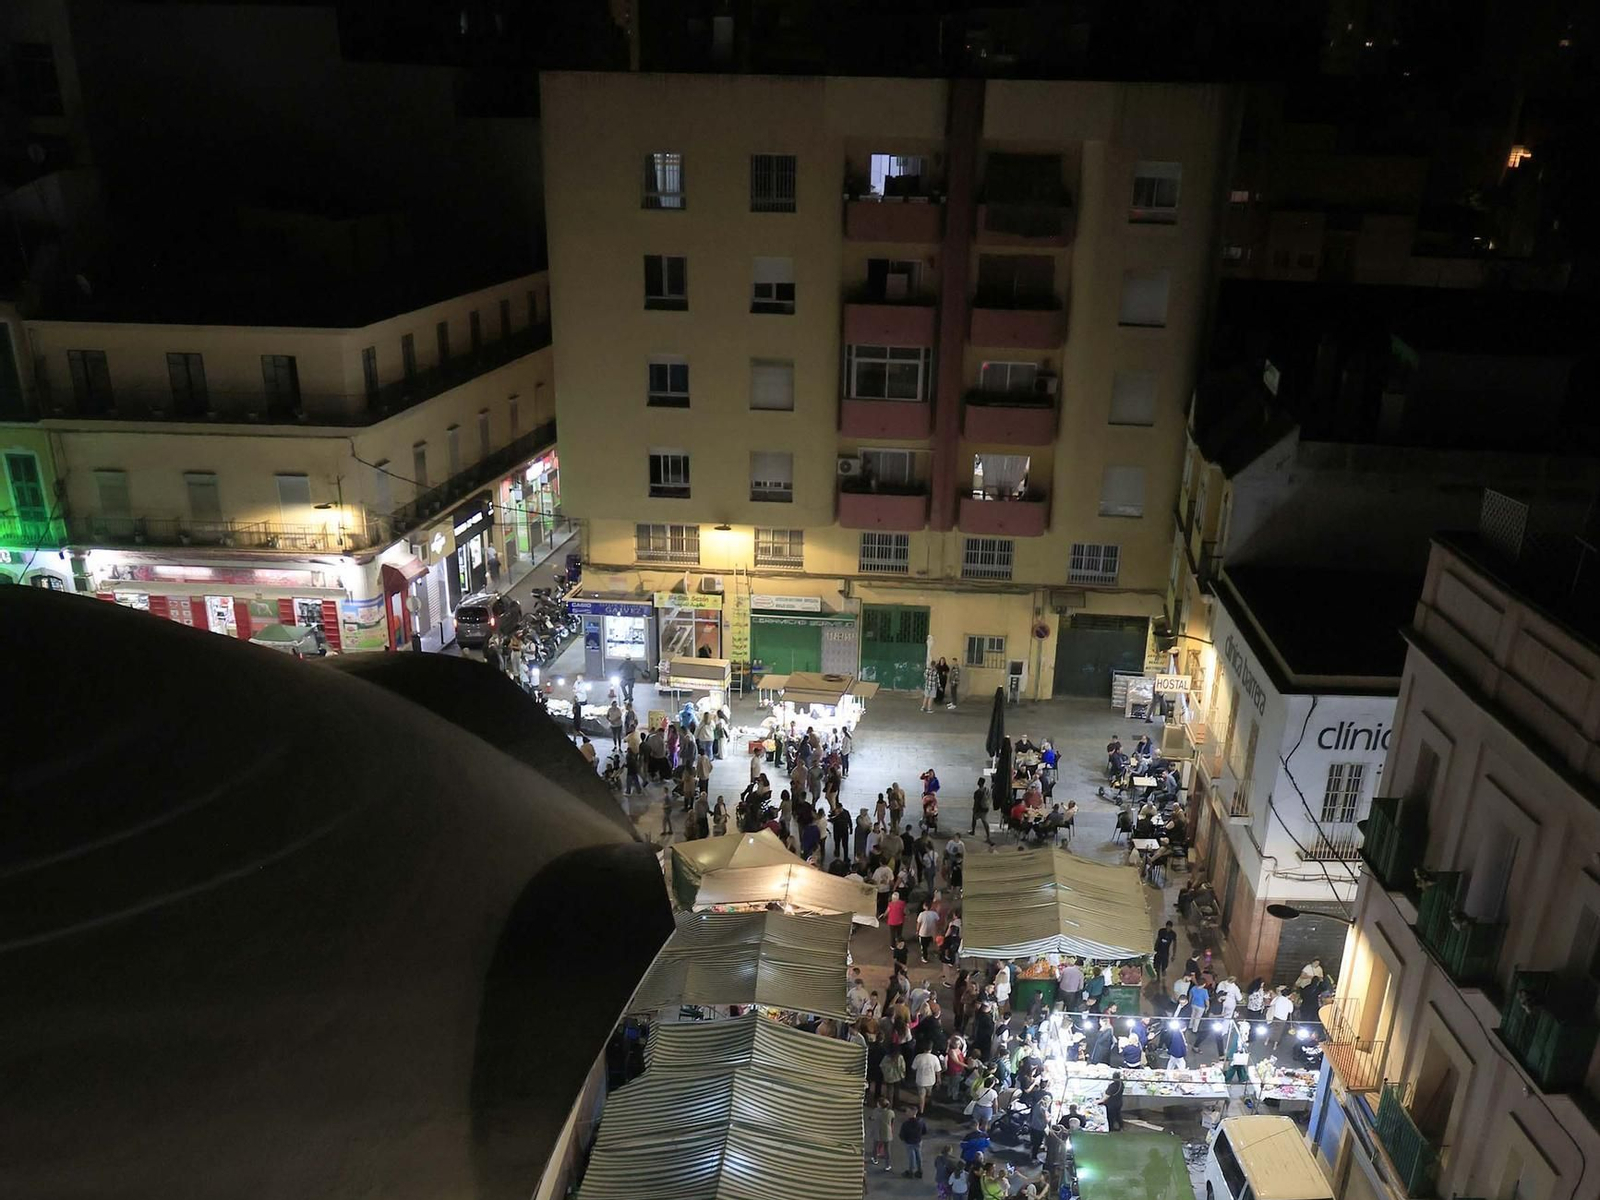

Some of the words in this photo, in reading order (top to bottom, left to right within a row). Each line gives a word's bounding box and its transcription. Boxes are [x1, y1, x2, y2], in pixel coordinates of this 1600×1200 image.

[1156, 678, 1189, 690] HOSTAL
[1242, 657, 1266, 717] barrera
[1317, 721, 1392, 751] clínic
